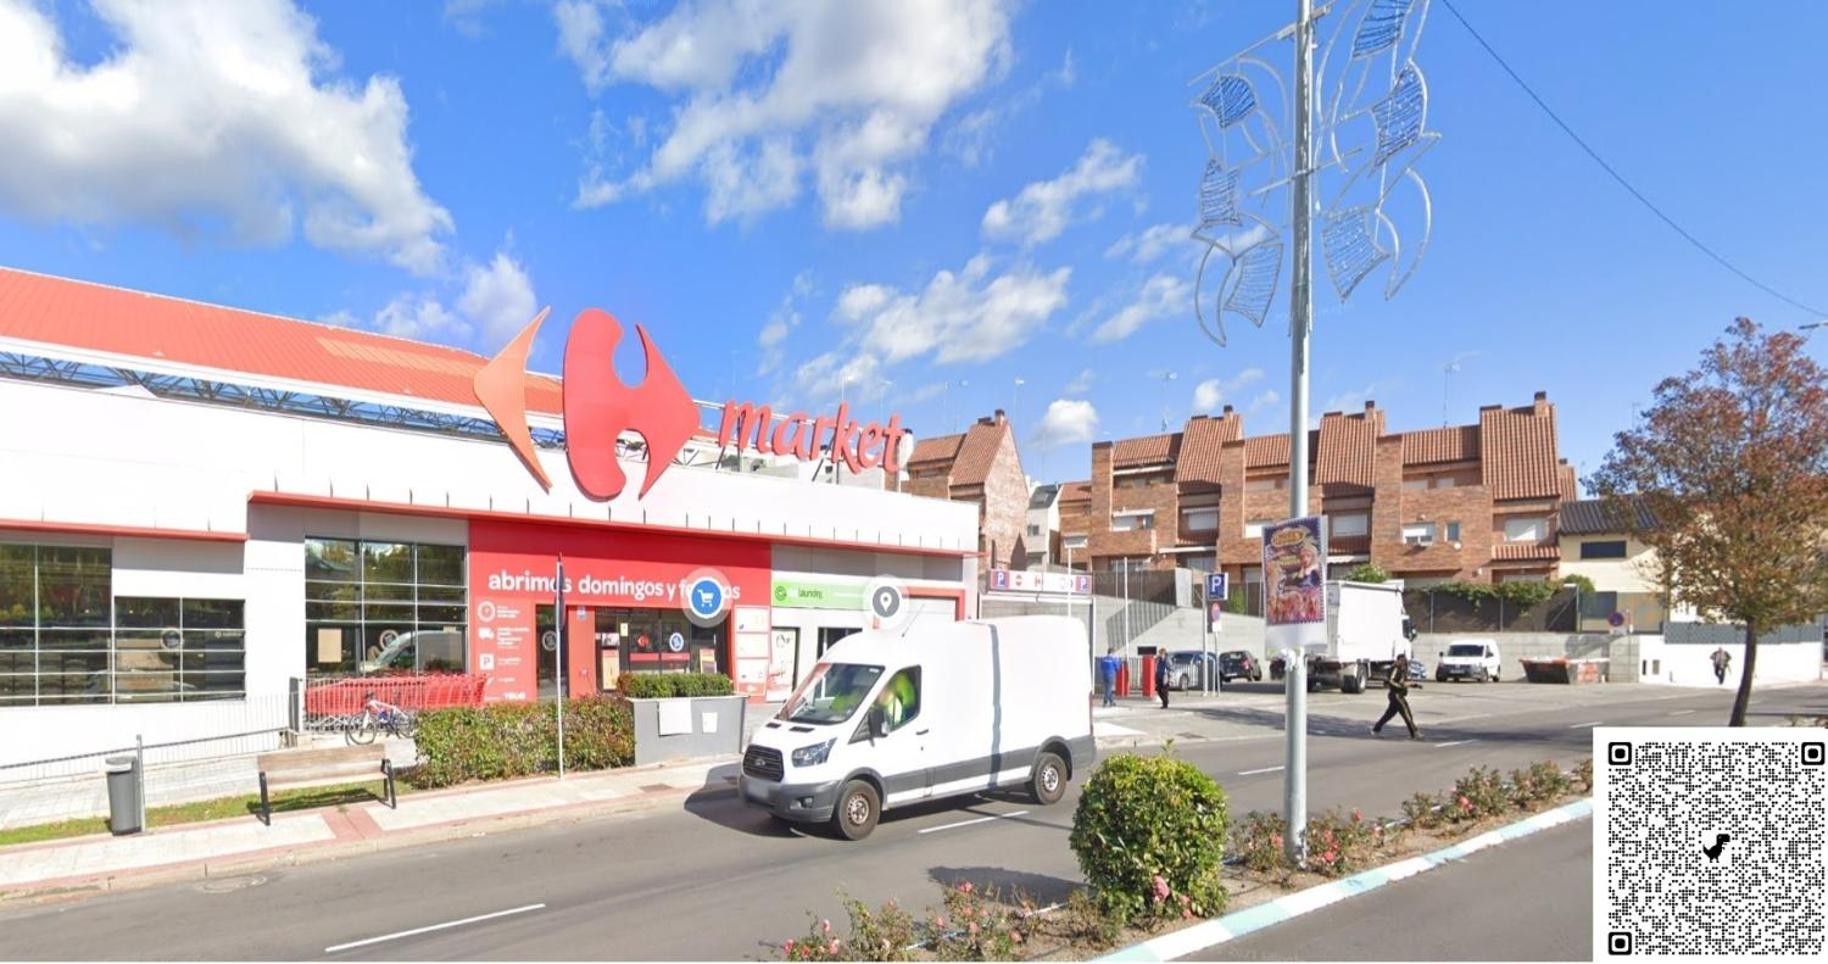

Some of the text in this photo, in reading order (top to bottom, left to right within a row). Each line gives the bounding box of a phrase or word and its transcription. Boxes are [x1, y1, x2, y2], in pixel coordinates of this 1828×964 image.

[719, 399, 905, 475] market
[488, 570, 572, 594] abrimos
[578, 575, 664, 601] domingos
[666, 582, 676, 602] y
[1211, 575, 1222, 593] P
